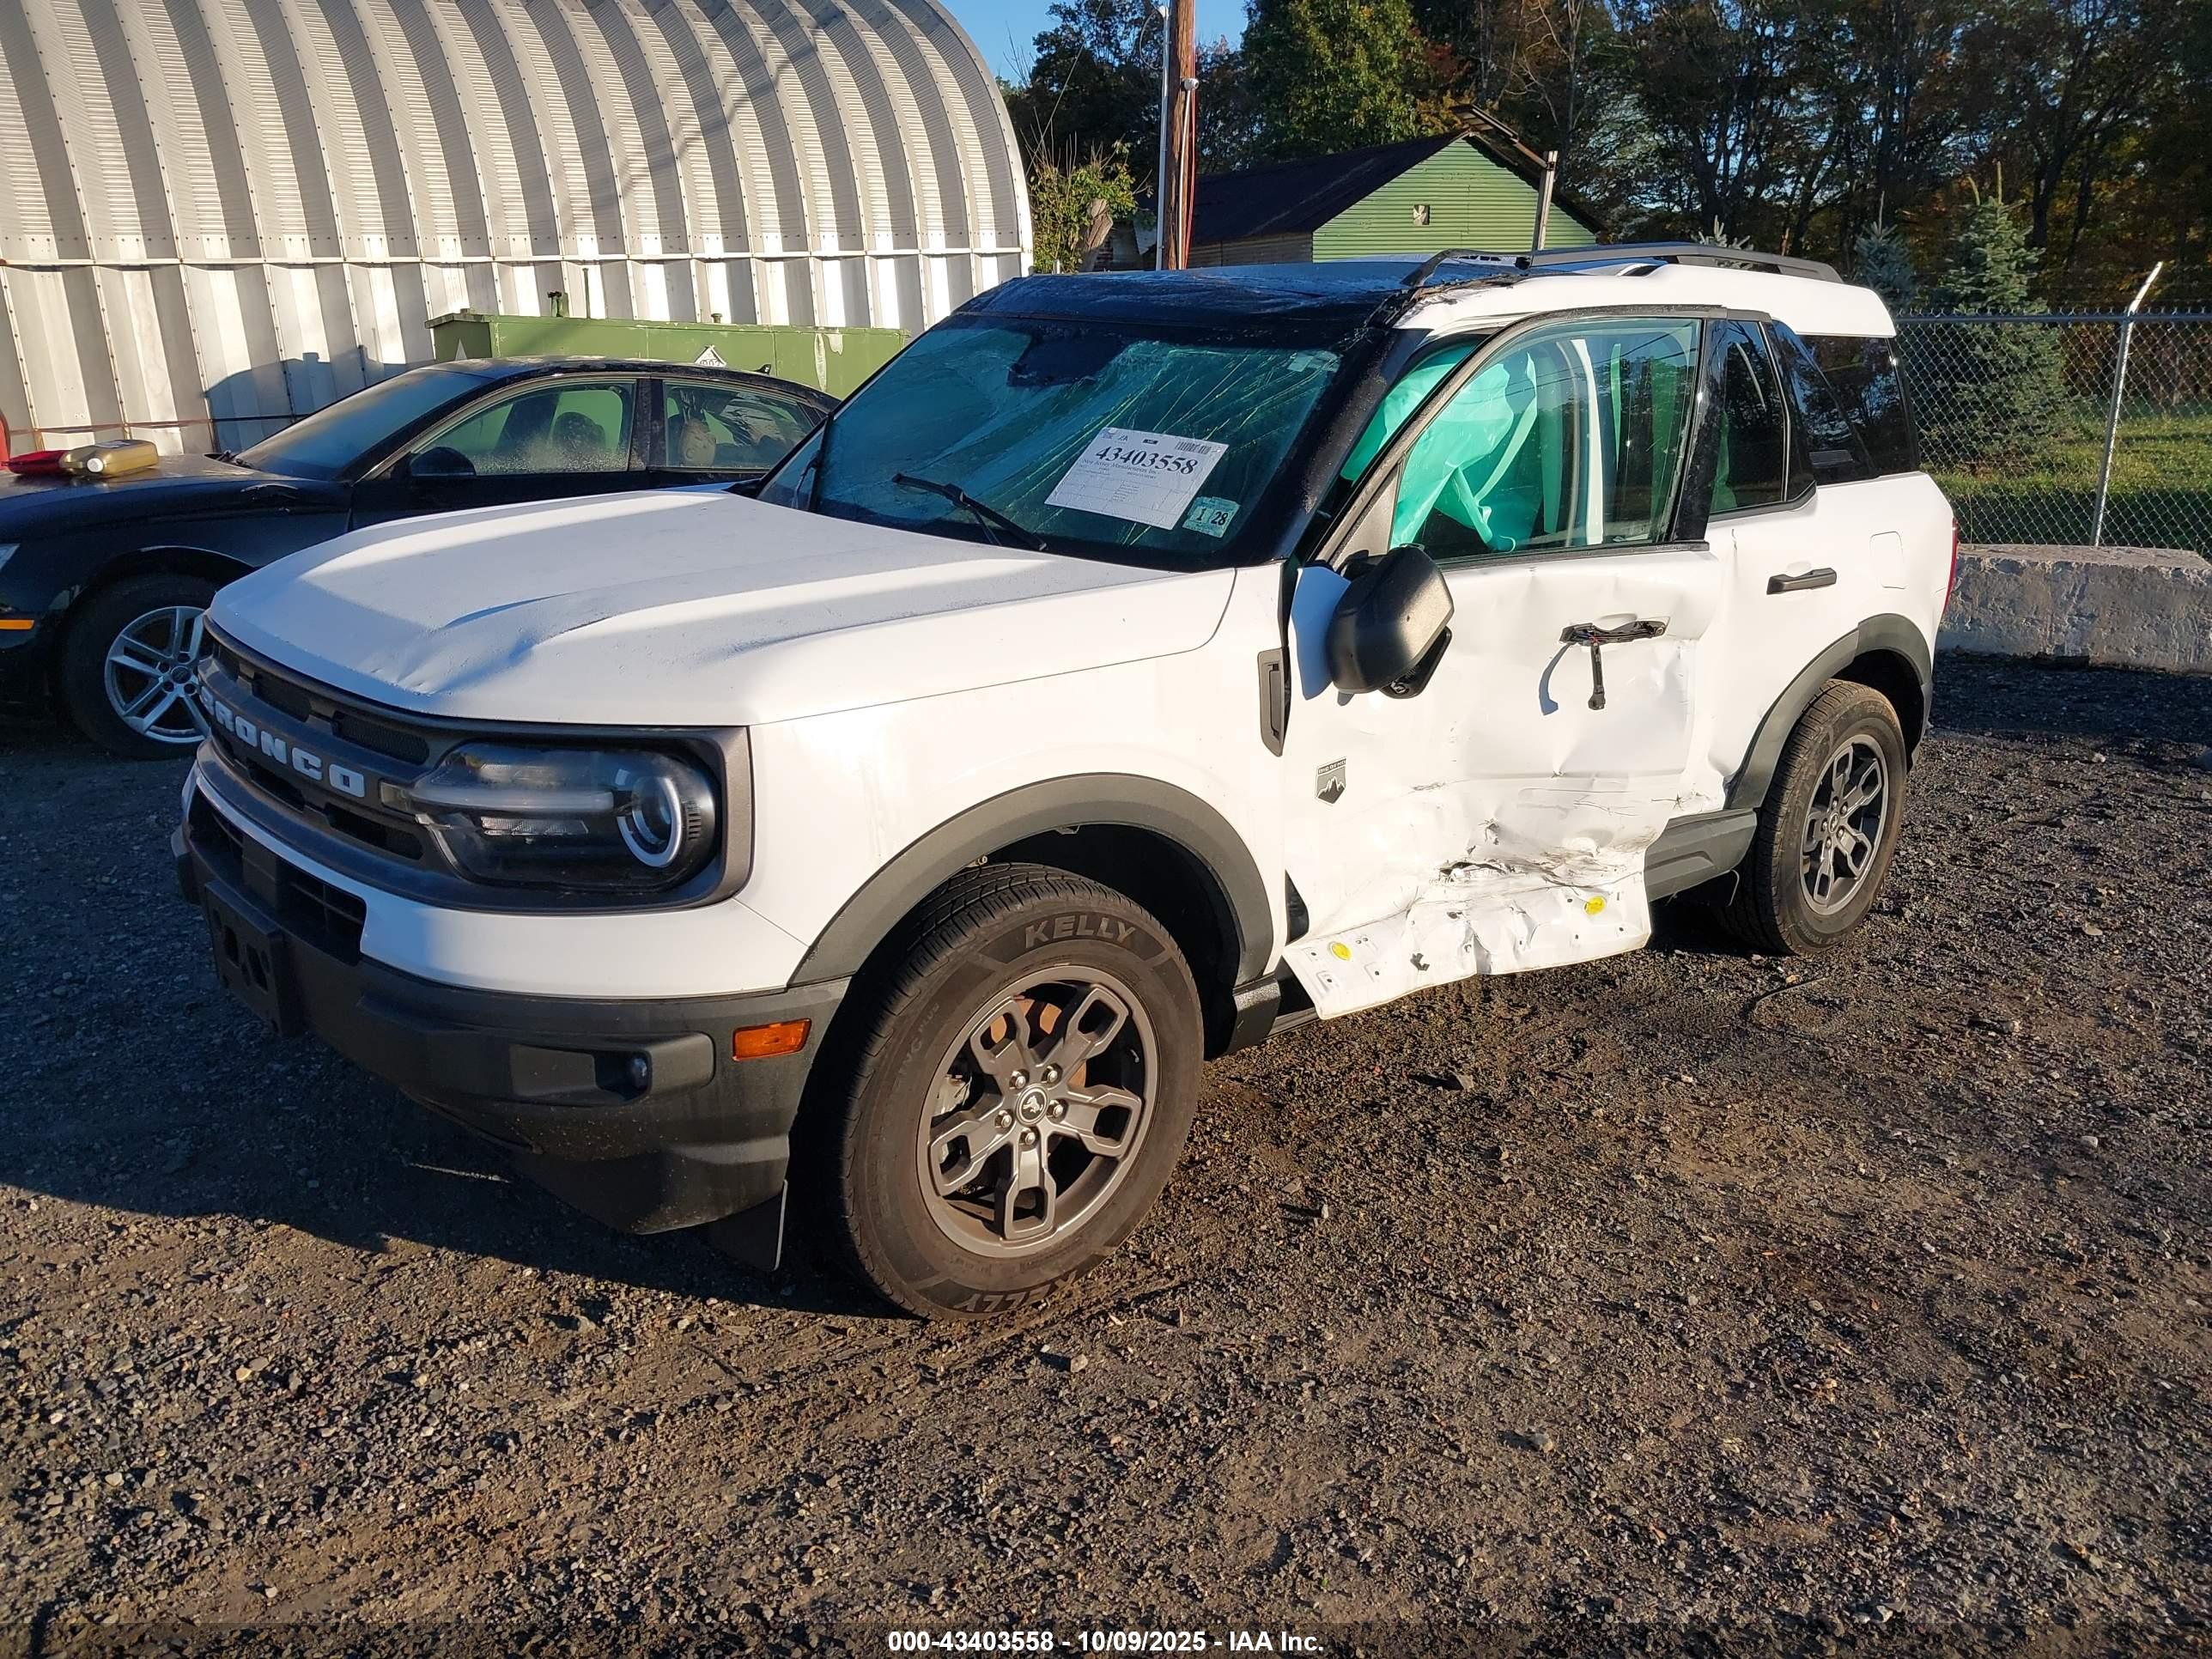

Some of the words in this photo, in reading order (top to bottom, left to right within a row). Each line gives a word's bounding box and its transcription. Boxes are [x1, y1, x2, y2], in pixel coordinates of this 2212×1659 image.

[1096, 446, 1198, 475] 43403558
[1211, 511, 1229, 526] 28
[200, 685, 365, 798] BRONCO
[1025, 915, 1136, 949] KELLY
